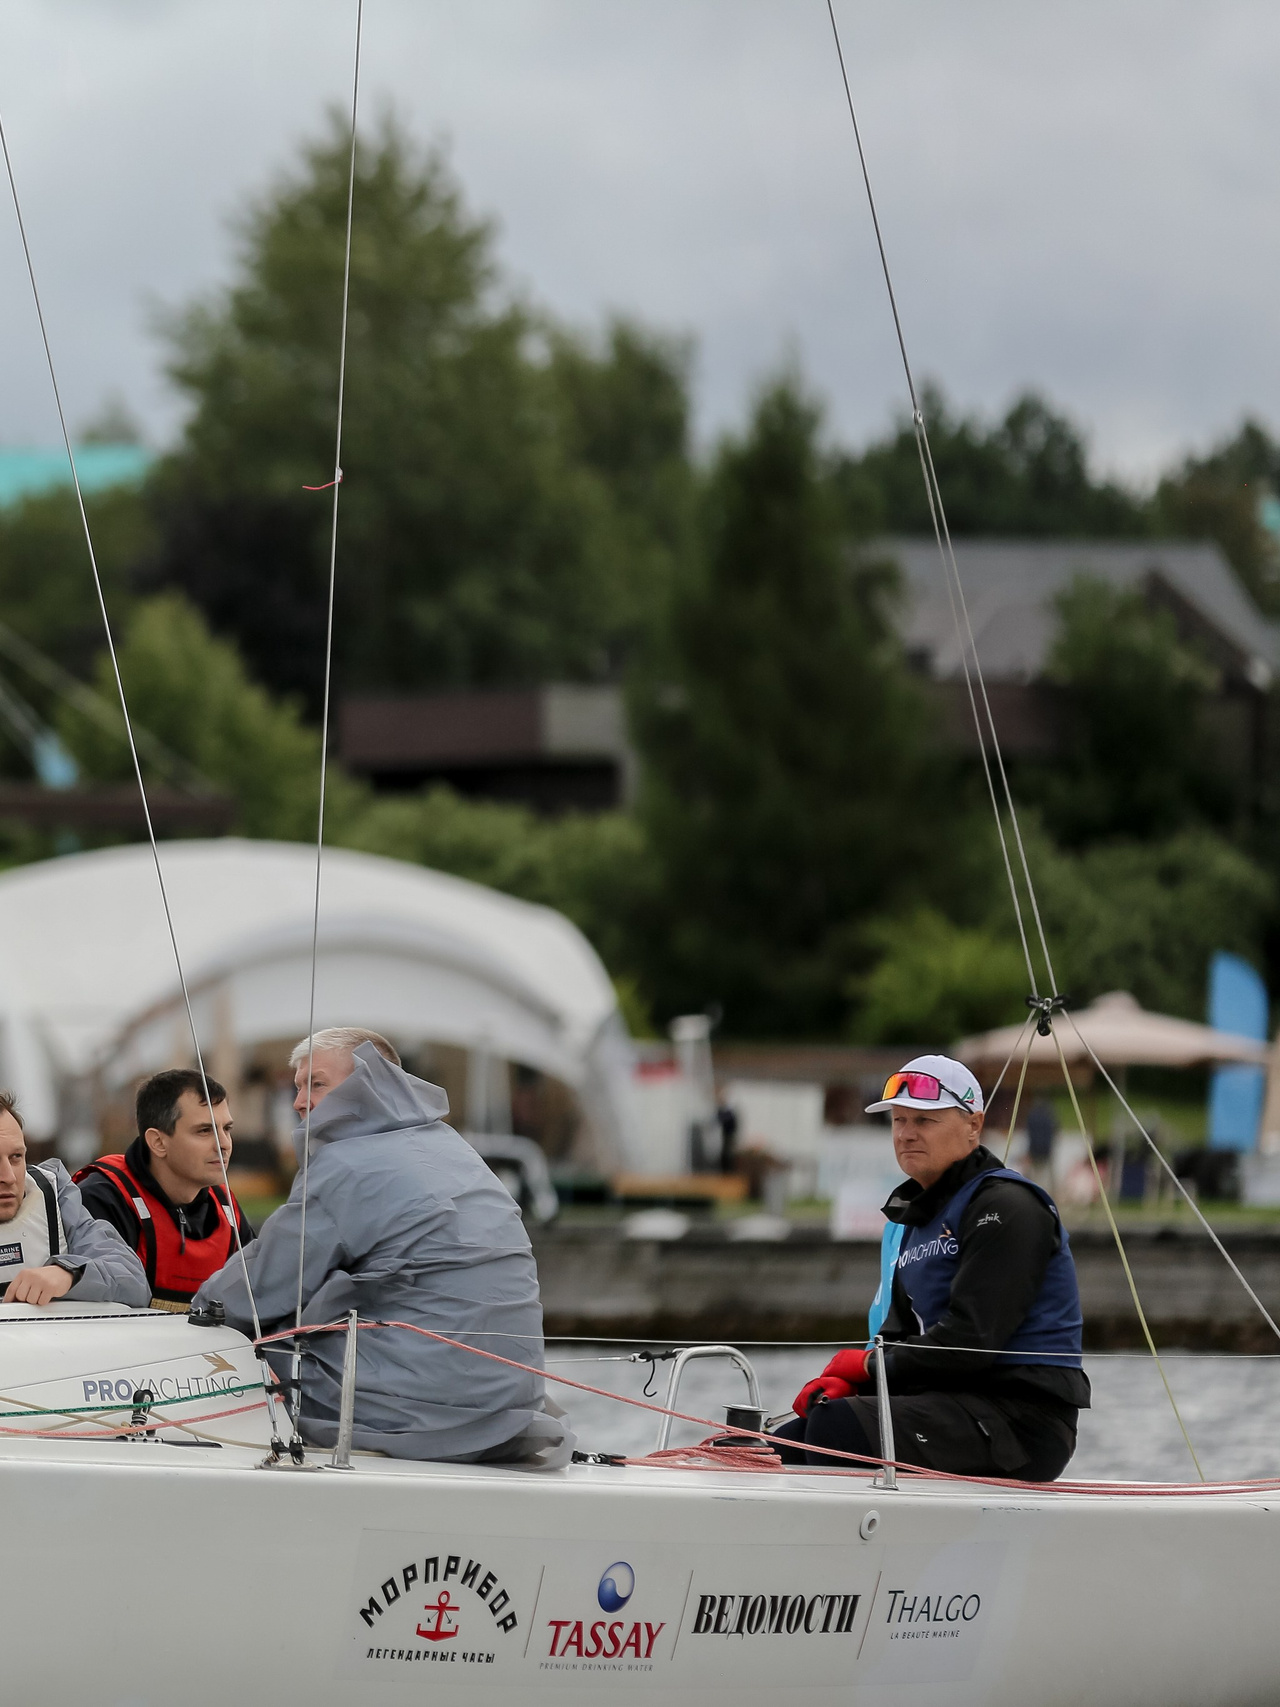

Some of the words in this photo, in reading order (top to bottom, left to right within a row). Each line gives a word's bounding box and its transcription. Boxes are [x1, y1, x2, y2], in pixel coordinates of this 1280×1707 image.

[977, 1213, 1002, 1227] zhik
[359, 1555, 518, 1635] МОРПРИБОР
[886, 1590, 981, 1624] THALGO
[691, 1594, 862, 1640] ВЕДОМОСТИ
[547, 1620, 666, 1659] TASSAY
[890, 1632, 899, 1640] LA
[932, 1629, 960, 1638] MARINE
[367, 1648, 457, 1662] ЛЕГЕНДАРНЫЕ
[462, 1652, 495, 1664] ЧАСЫ
[539, 1662, 578, 1671] PREMIUM
[581, 1663, 624, 1672] DRINKING
[627, 1664, 654, 1672] WATER
